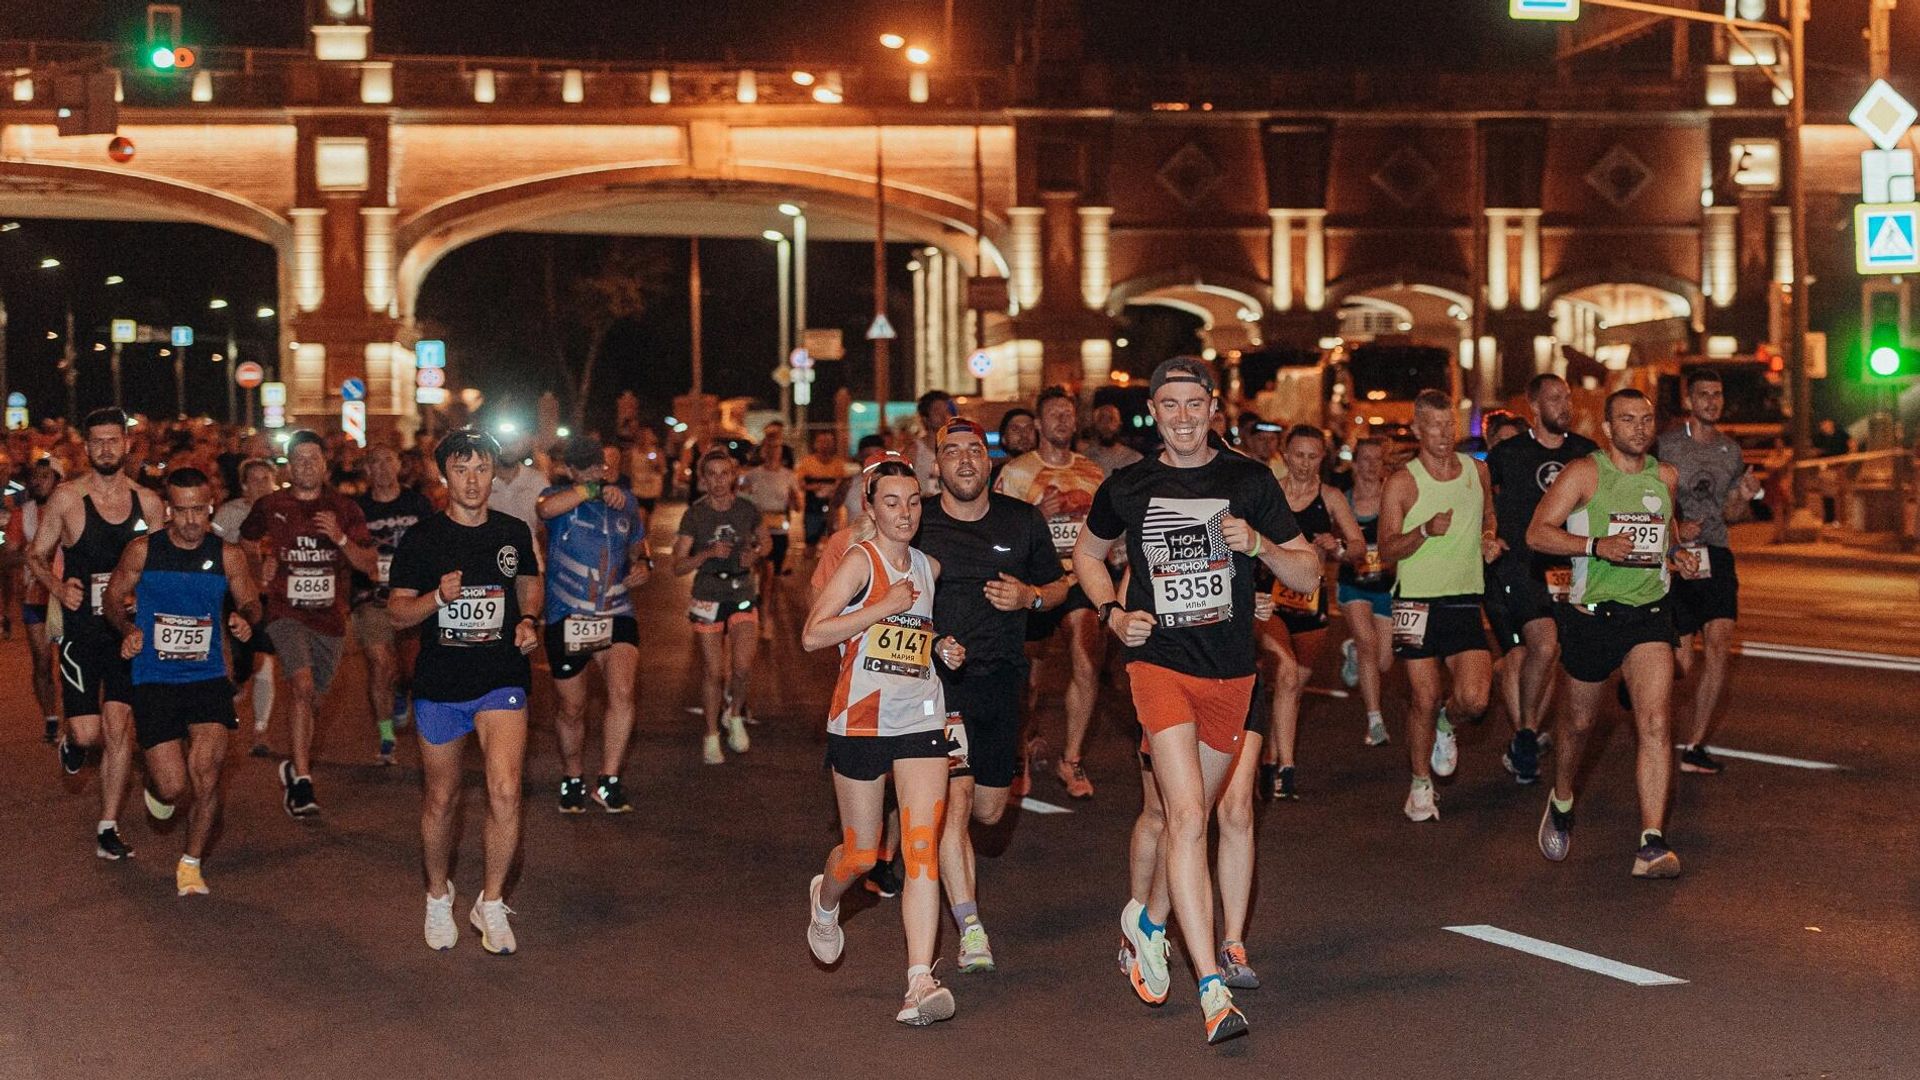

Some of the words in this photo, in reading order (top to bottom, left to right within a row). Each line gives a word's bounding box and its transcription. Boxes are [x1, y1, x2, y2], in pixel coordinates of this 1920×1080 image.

[1619, 525, 1659, 544] 395
[297, 536, 317, 549] Fly
[294, 579, 330, 592] 6868
[1164, 574, 1223, 602] 5358
[447, 601, 496, 620] 5069
[1185, 601, 1206, 609] ИЛЬЯ
[161, 628, 204, 645] 8755
[571, 622, 608, 636] 3619
[878, 628, 928, 655] 6147
[891, 652, 915, 662] МАРИЯ
